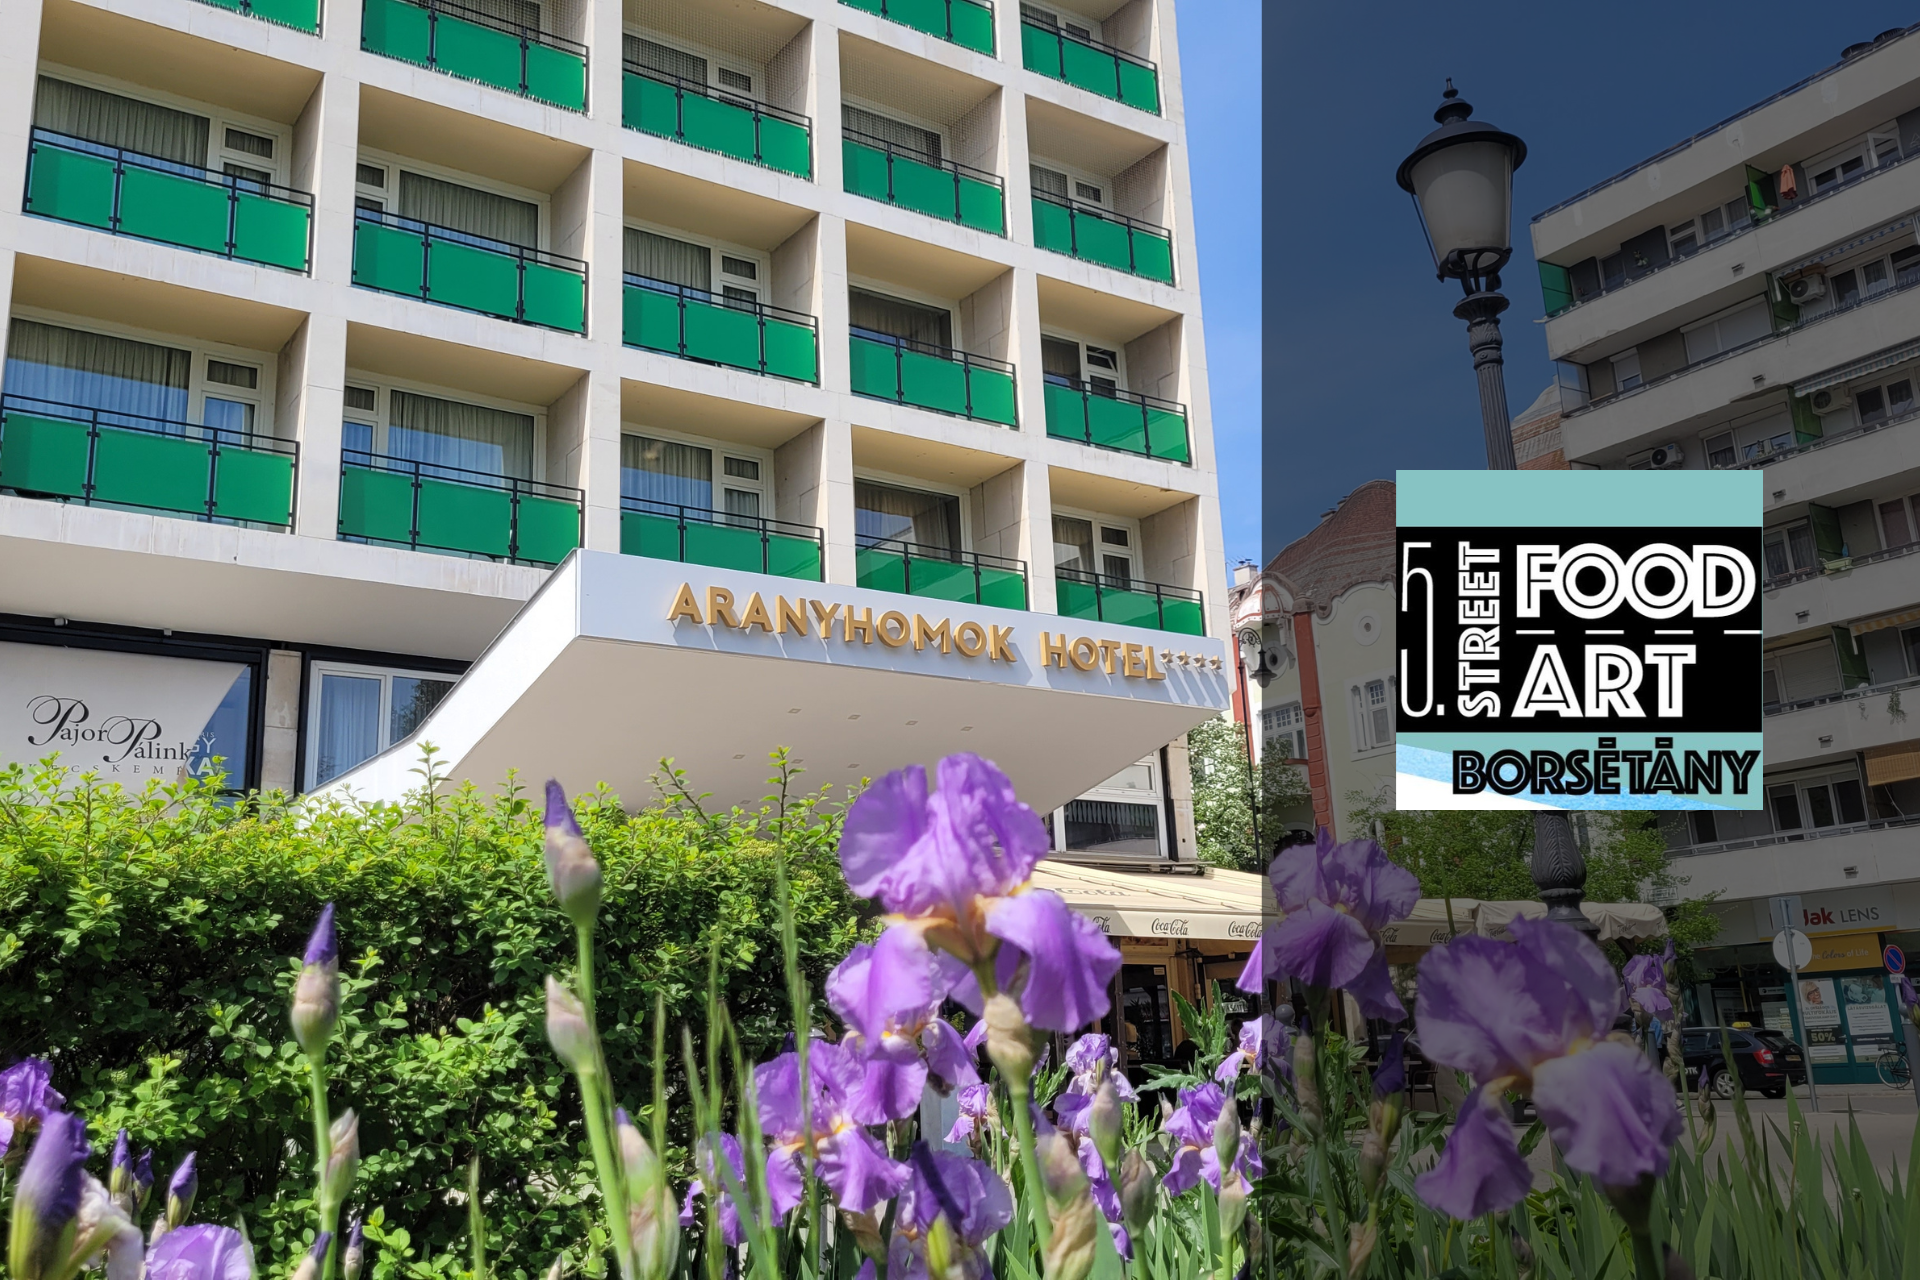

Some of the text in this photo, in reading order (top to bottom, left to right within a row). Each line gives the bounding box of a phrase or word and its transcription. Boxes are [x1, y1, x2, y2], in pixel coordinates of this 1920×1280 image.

[666, 581, 1166, 680] ARANYHOMOK HOTEL
[26, 695, 192, 763] Pajor Pálink
[1840, 907, 1880, 923] LENS
[1822, 950, 1845, 959] Colors
[1847, 949, 1854, 957] of
[1855, 948, 1869, 957] Life
[1811, 1032, 1836, 1042] 50%
